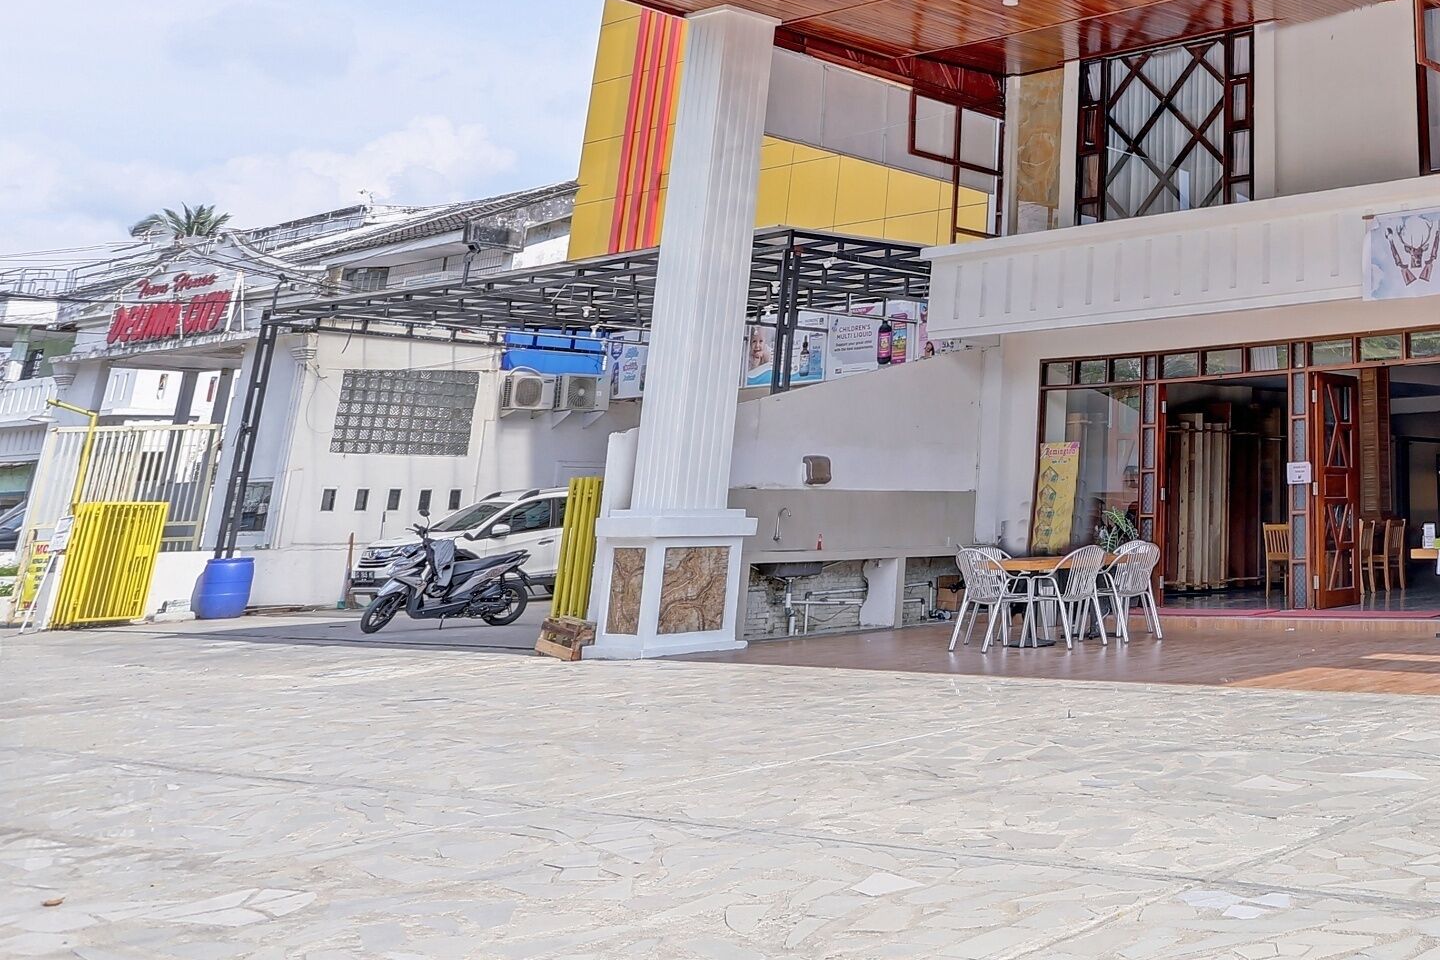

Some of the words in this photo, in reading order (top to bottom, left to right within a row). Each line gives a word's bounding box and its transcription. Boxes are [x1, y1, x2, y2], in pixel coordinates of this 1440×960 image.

[173, 272, 219, 292] House
[183, 290, 233, 334] CITY
[839, 324, 871, 332] CHILDREN'S
[853, 331, 872, 339] LIQUID
